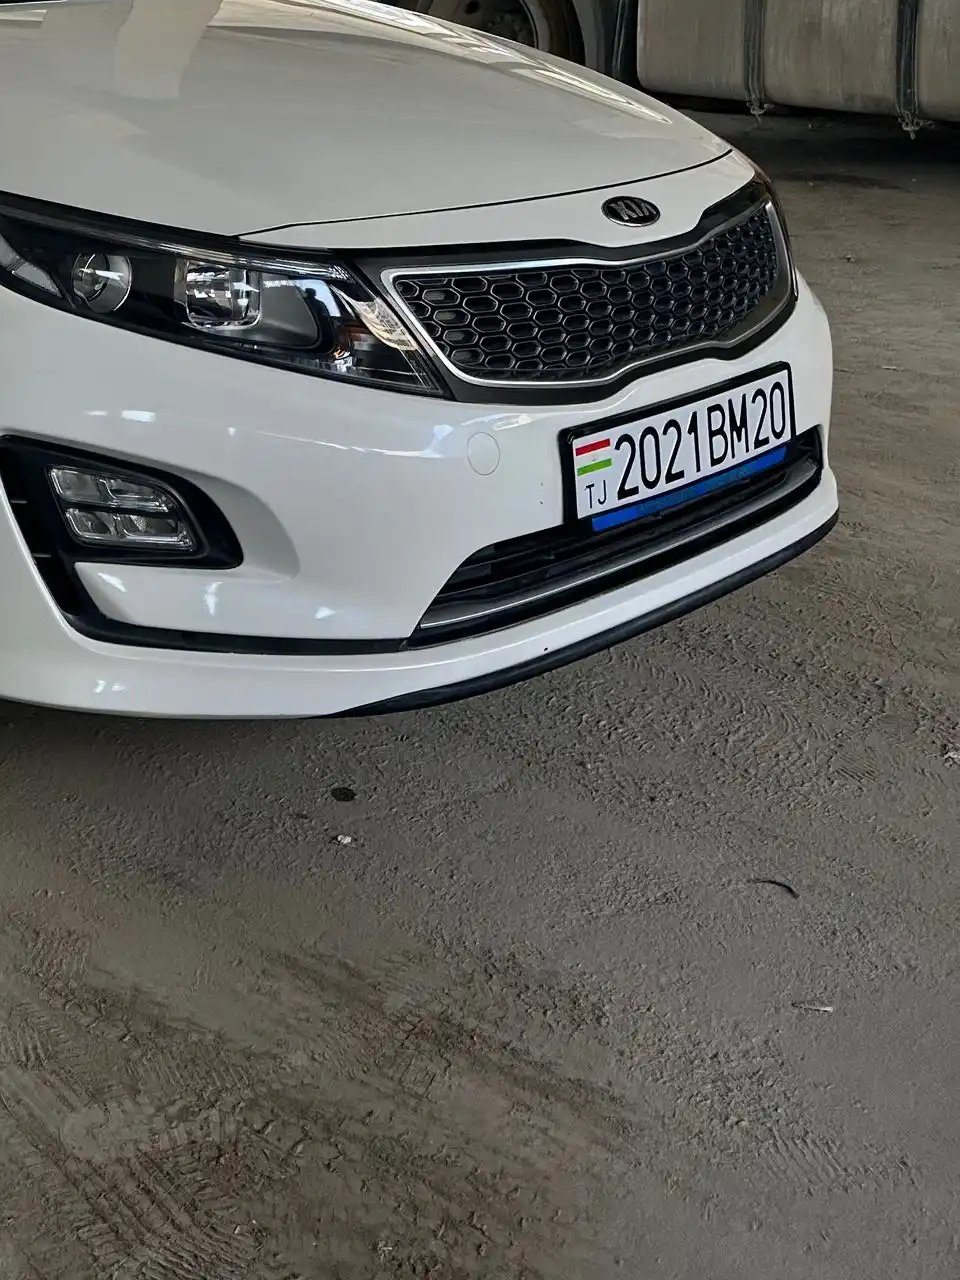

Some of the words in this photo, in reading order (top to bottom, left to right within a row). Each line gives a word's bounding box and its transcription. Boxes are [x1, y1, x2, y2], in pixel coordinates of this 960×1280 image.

[607, 199, 657, 221] KIA
[614, 381, 787, 501] 2021BM20
[585, 478, 608, 510] TJ
